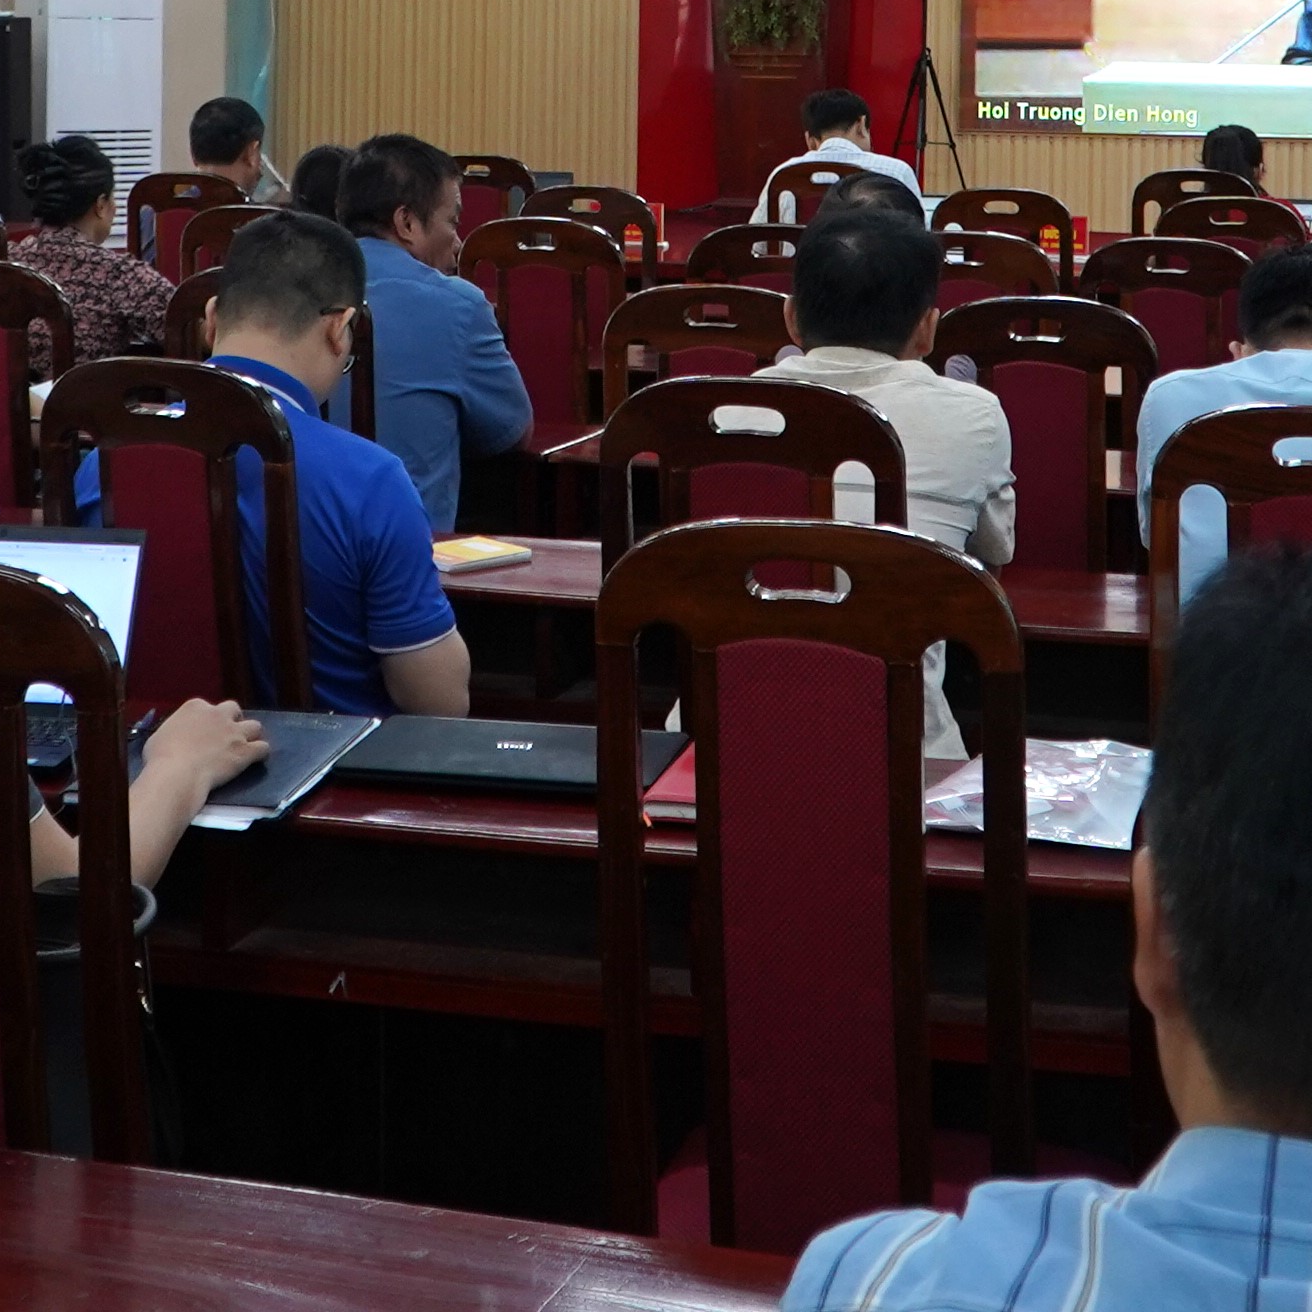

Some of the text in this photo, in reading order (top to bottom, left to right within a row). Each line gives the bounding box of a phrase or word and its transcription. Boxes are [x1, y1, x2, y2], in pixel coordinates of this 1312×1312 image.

[978, 101, 1198, 128] Hoi Truong Dien Hong
